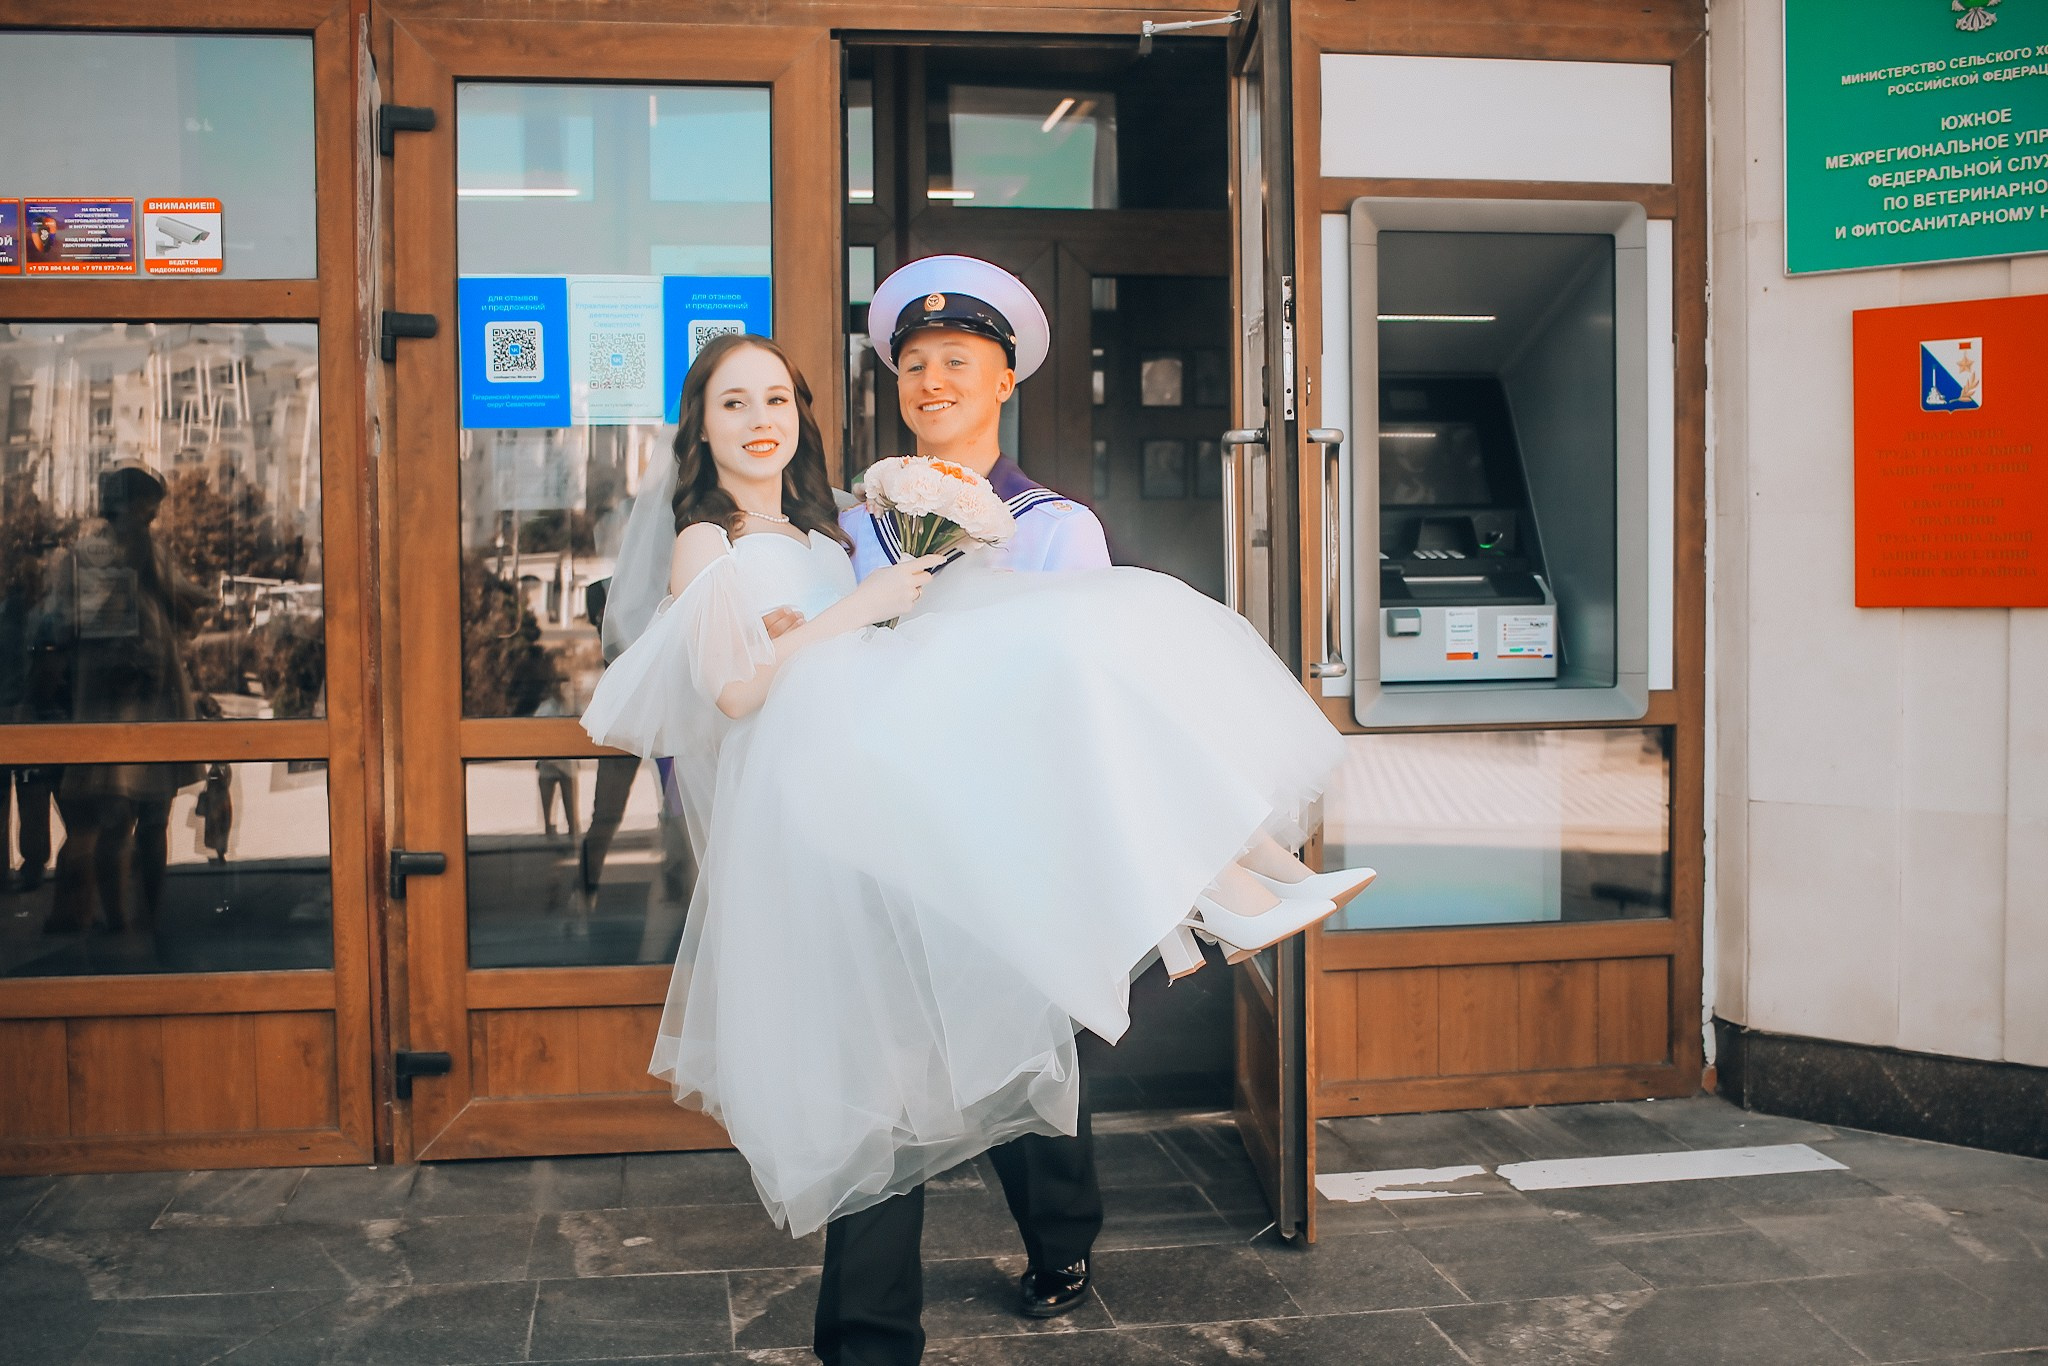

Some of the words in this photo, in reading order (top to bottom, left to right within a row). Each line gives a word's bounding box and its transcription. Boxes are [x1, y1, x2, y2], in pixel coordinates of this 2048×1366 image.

[1841, 60, 1947, 86] МИНИСТЕРСТВО
[1949, 47, 2032, 69] СЕЛЬСКОГО
[1888, 71, 1979, 96] РОССИЙСКОЙ
[1982, 63, 2048, 82] ФЕДЕРАЦ
[1941, 108, 2012, 131] ЮЖНОЕ
[1825, 133, 2009, 170] МЕЖРЕГИОНАЛЬНОЕ
[2014, 128, 2048, 146] УПР
[1868, 156, 2002, 188] ФЕДЕРАЛЬНОЙ
[148, 202, 215, 210] ВНИМАНИЕ!!!
[1883, 196, 1909, 211] ПО
[1913, 179, 2048, 208] ВЕТЕРИНАРНО
[1835, 227, 1847, 240] И
[1851, 206, 2035, 238] ФИТОСАНИТАРНОМУ
[487, 295, 503, 303] для
[488, 303, 546, 312] предложений
[692, 302, 749, 311] предложений
[472, 393, 511, 401] Гагаринский
